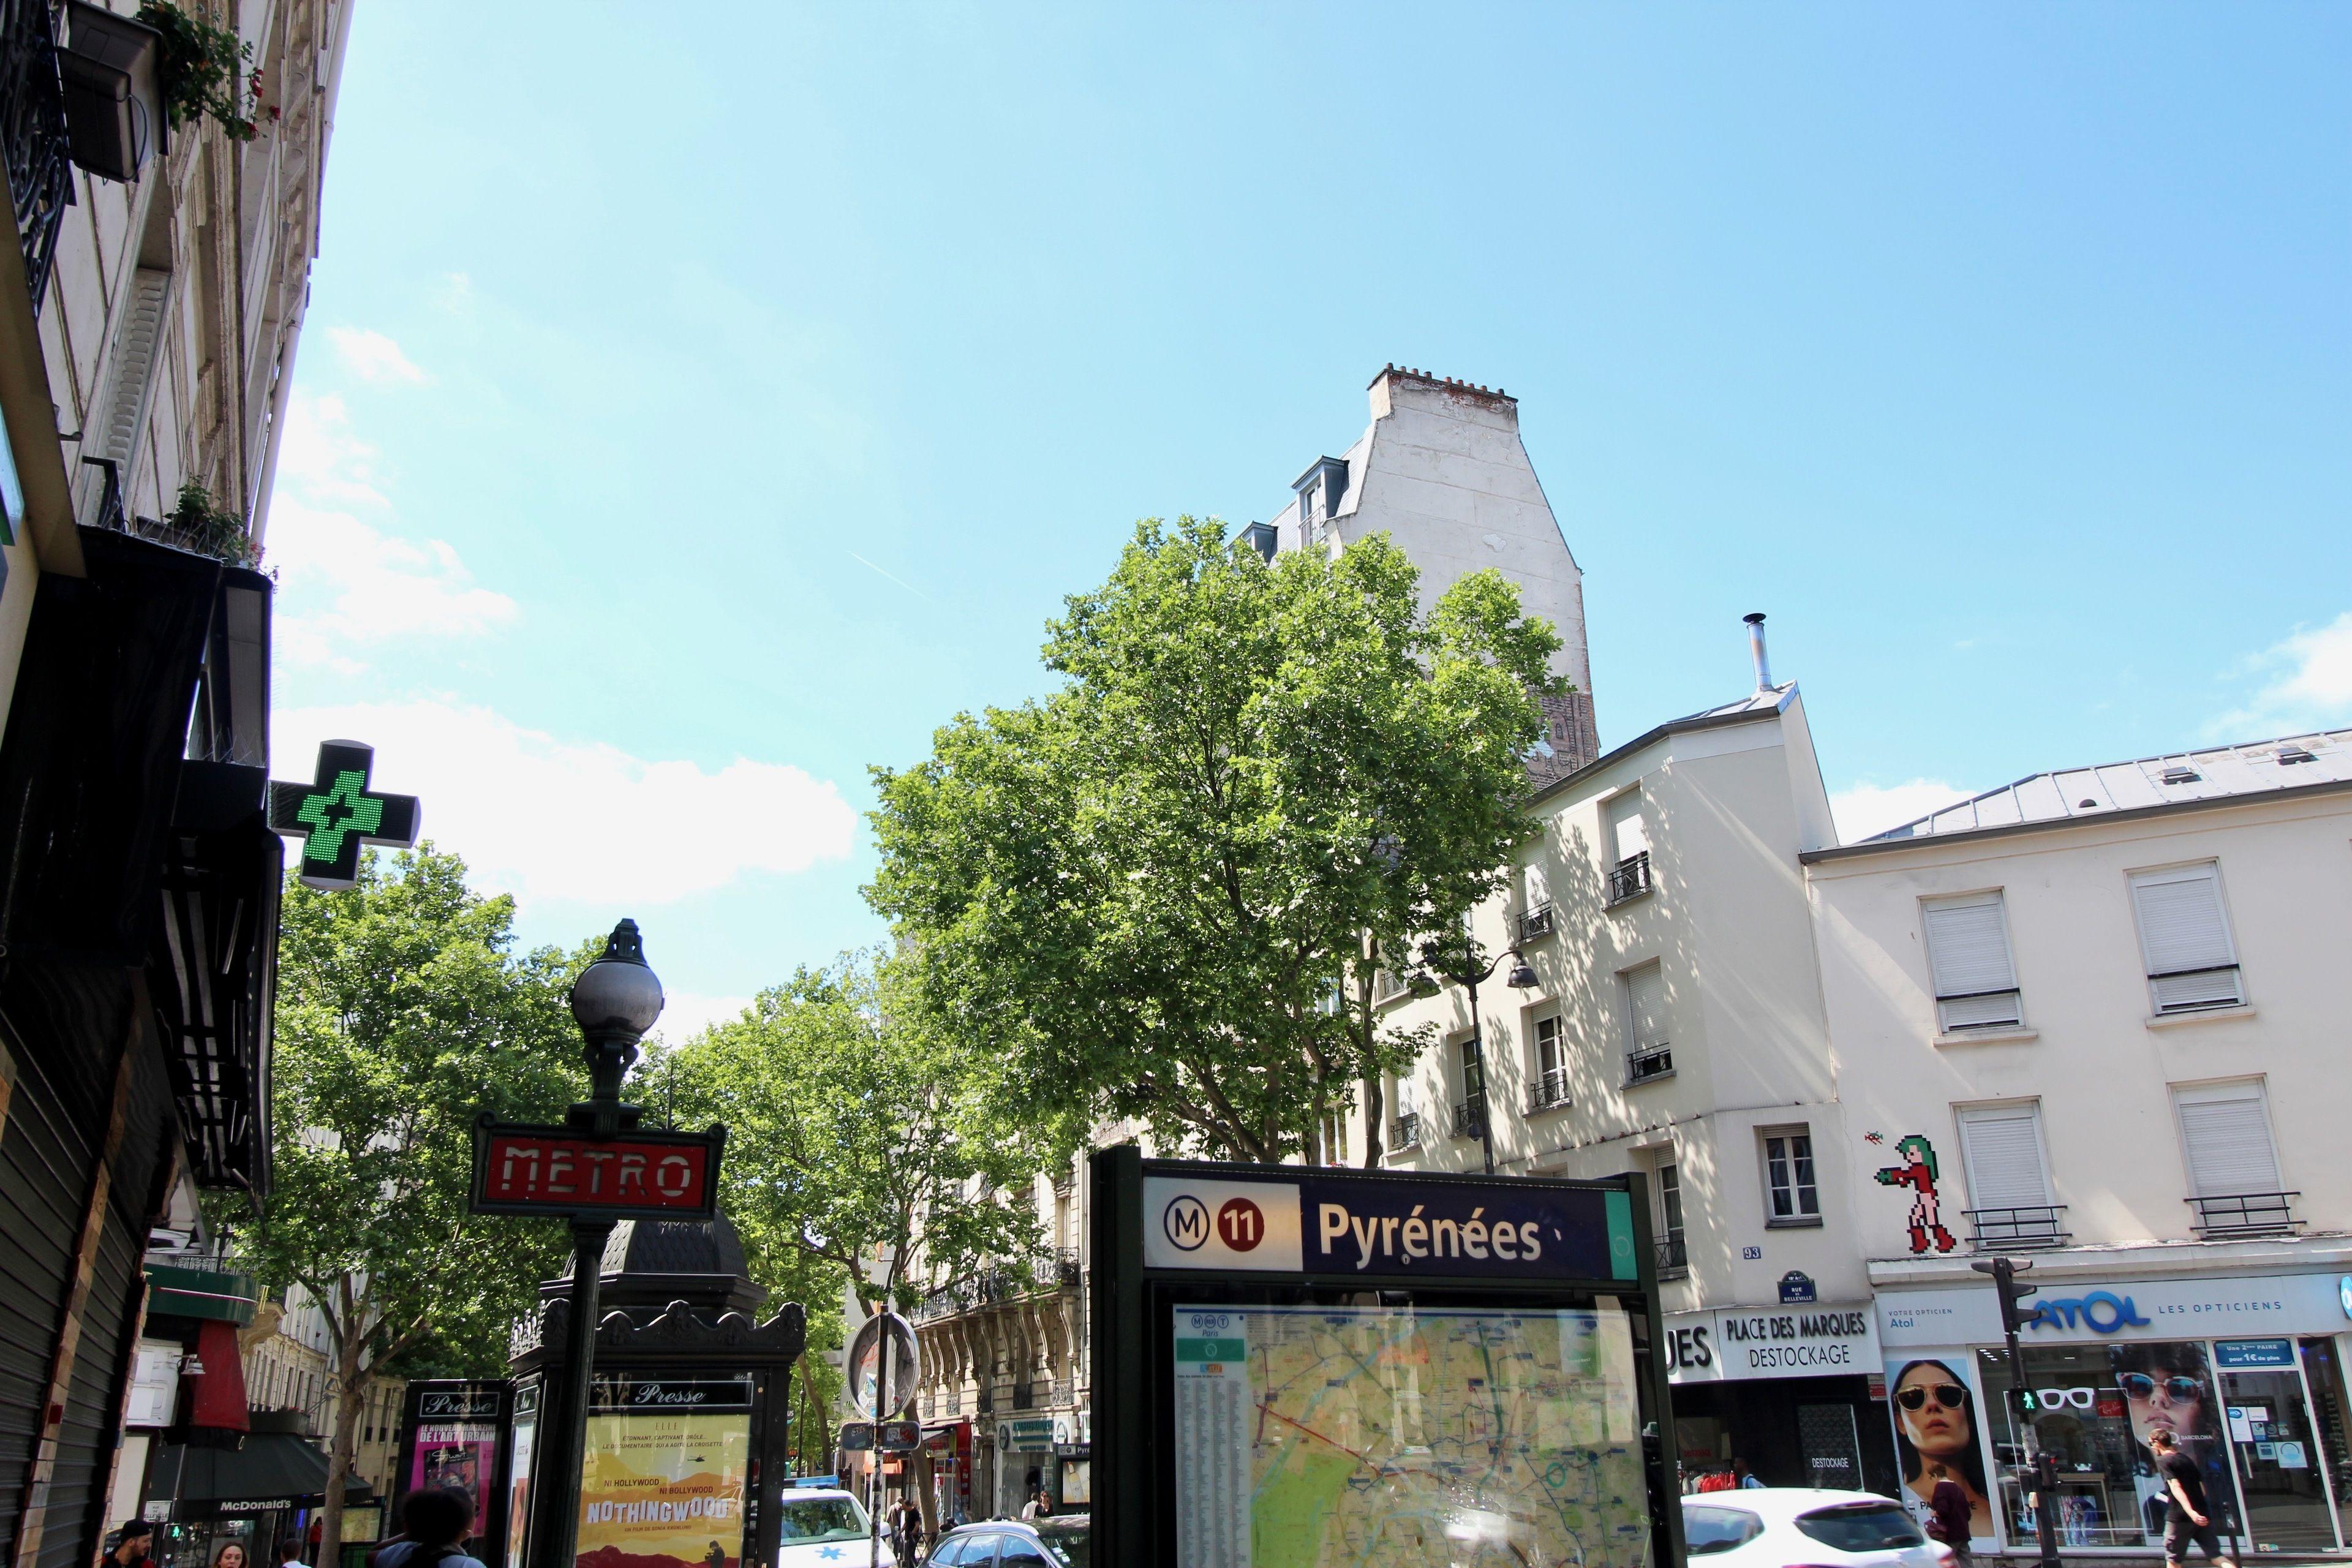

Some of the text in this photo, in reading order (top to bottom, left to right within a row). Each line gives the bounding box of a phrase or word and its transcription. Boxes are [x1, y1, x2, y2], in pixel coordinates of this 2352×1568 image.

[502, 1147, 690, 1196] METRO
[1175, 1204, 1542, 1270] M 11 Pyrénées
[1744, 1248, 1759, 1258] 93
[2030, 1291, 2150, 1333] ATOL
[2158, 1301, 2282, 1314] LES OPTICIENS
[1726, 1311, 1866, 1341] PLACE DES MARQUES
[1890, 1317, 1913, 1328] Atol
[1749, 1344, 1850, 1368] DESTOCKAGE
[635, 1384, 706, 1403] Presse
[425, 1395, 494, 1413] Presse
[420, 1431, 496, 1442] DE L'ART URBAIN
[1812, 1458, 1849, 1468] DESTOCKAGE
[614, 1478, 660, 1487] HOLLYWOOD
[669, 1486, 714, 1494] BOLLYWOOD
[221, 1499, 291, 1511] McDonald's
[587, 1496, 729, 1524] NOTHINGWOOD
